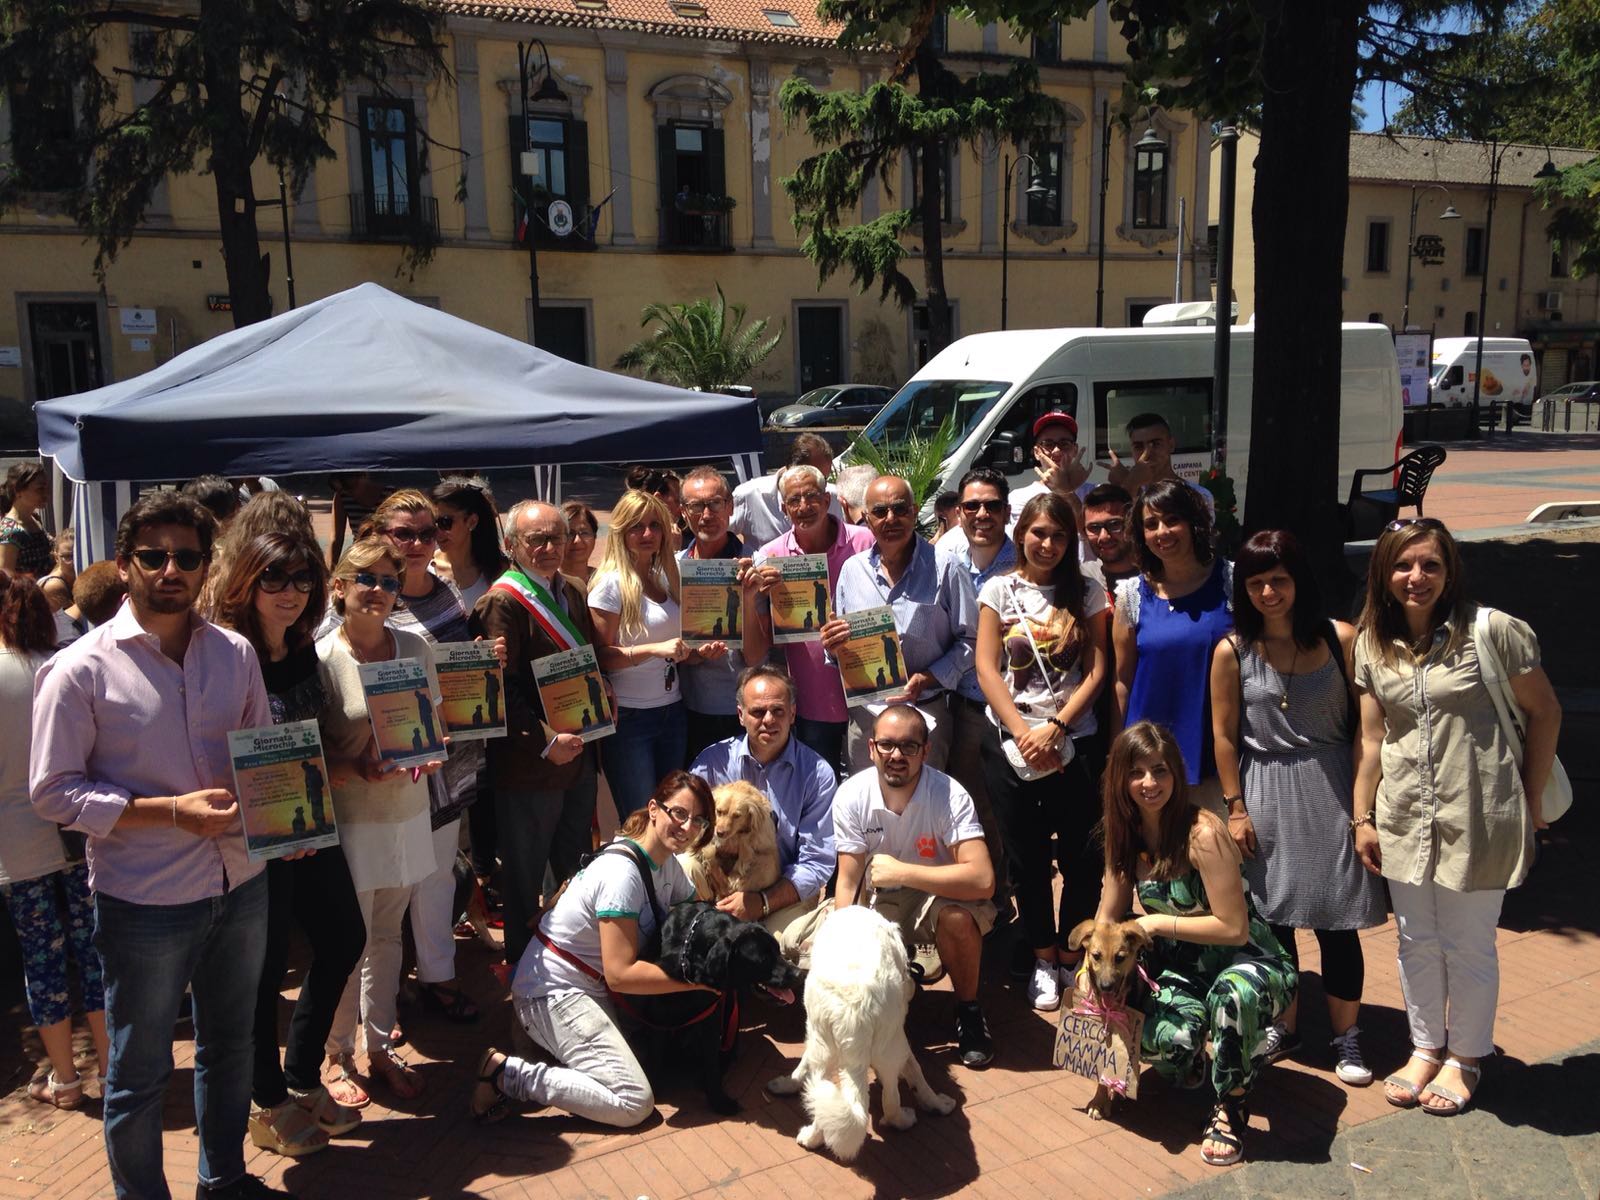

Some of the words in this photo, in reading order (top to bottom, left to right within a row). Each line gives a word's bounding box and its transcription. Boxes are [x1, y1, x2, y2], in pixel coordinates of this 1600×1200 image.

[1173, 462, 1202, 470] CAMPANIA
[253, 735, 293, 746] Giornata
[253, 741, 297, 753] Microchip
[1063, 1015, 1107, 1045] CERCO
[1057, 1032, 1117, 1075] MAMMA
[1055, 1047, 1101, 1082] UMANA
